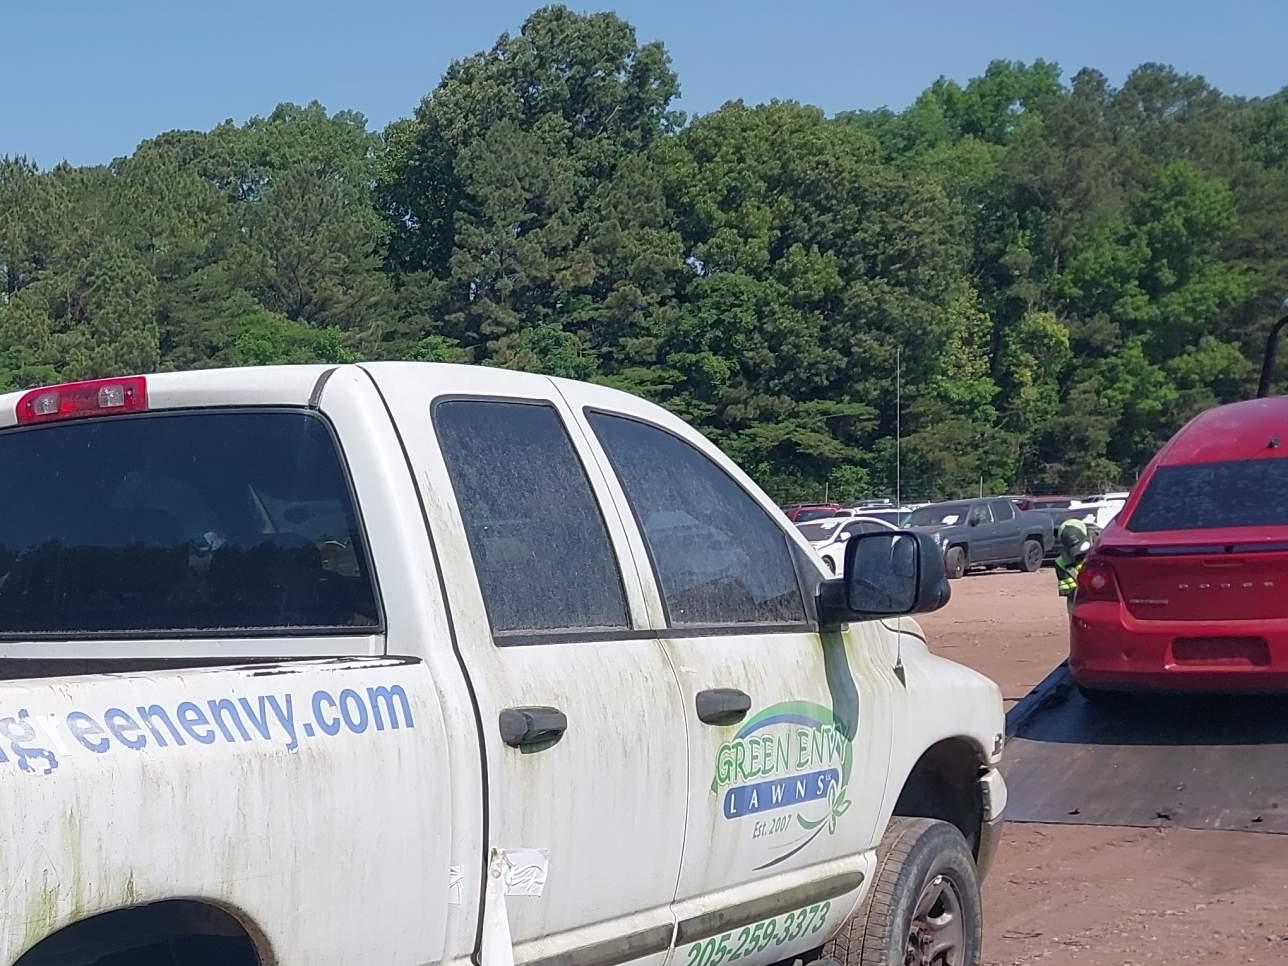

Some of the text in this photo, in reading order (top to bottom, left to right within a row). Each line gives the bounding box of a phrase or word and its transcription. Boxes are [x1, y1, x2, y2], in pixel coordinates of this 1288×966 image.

[717, 722, 850, 785] GREEN ENVY
[729, 774, 825, 814] LAWNS
[752, 814, 792, 839] Est. 2007
